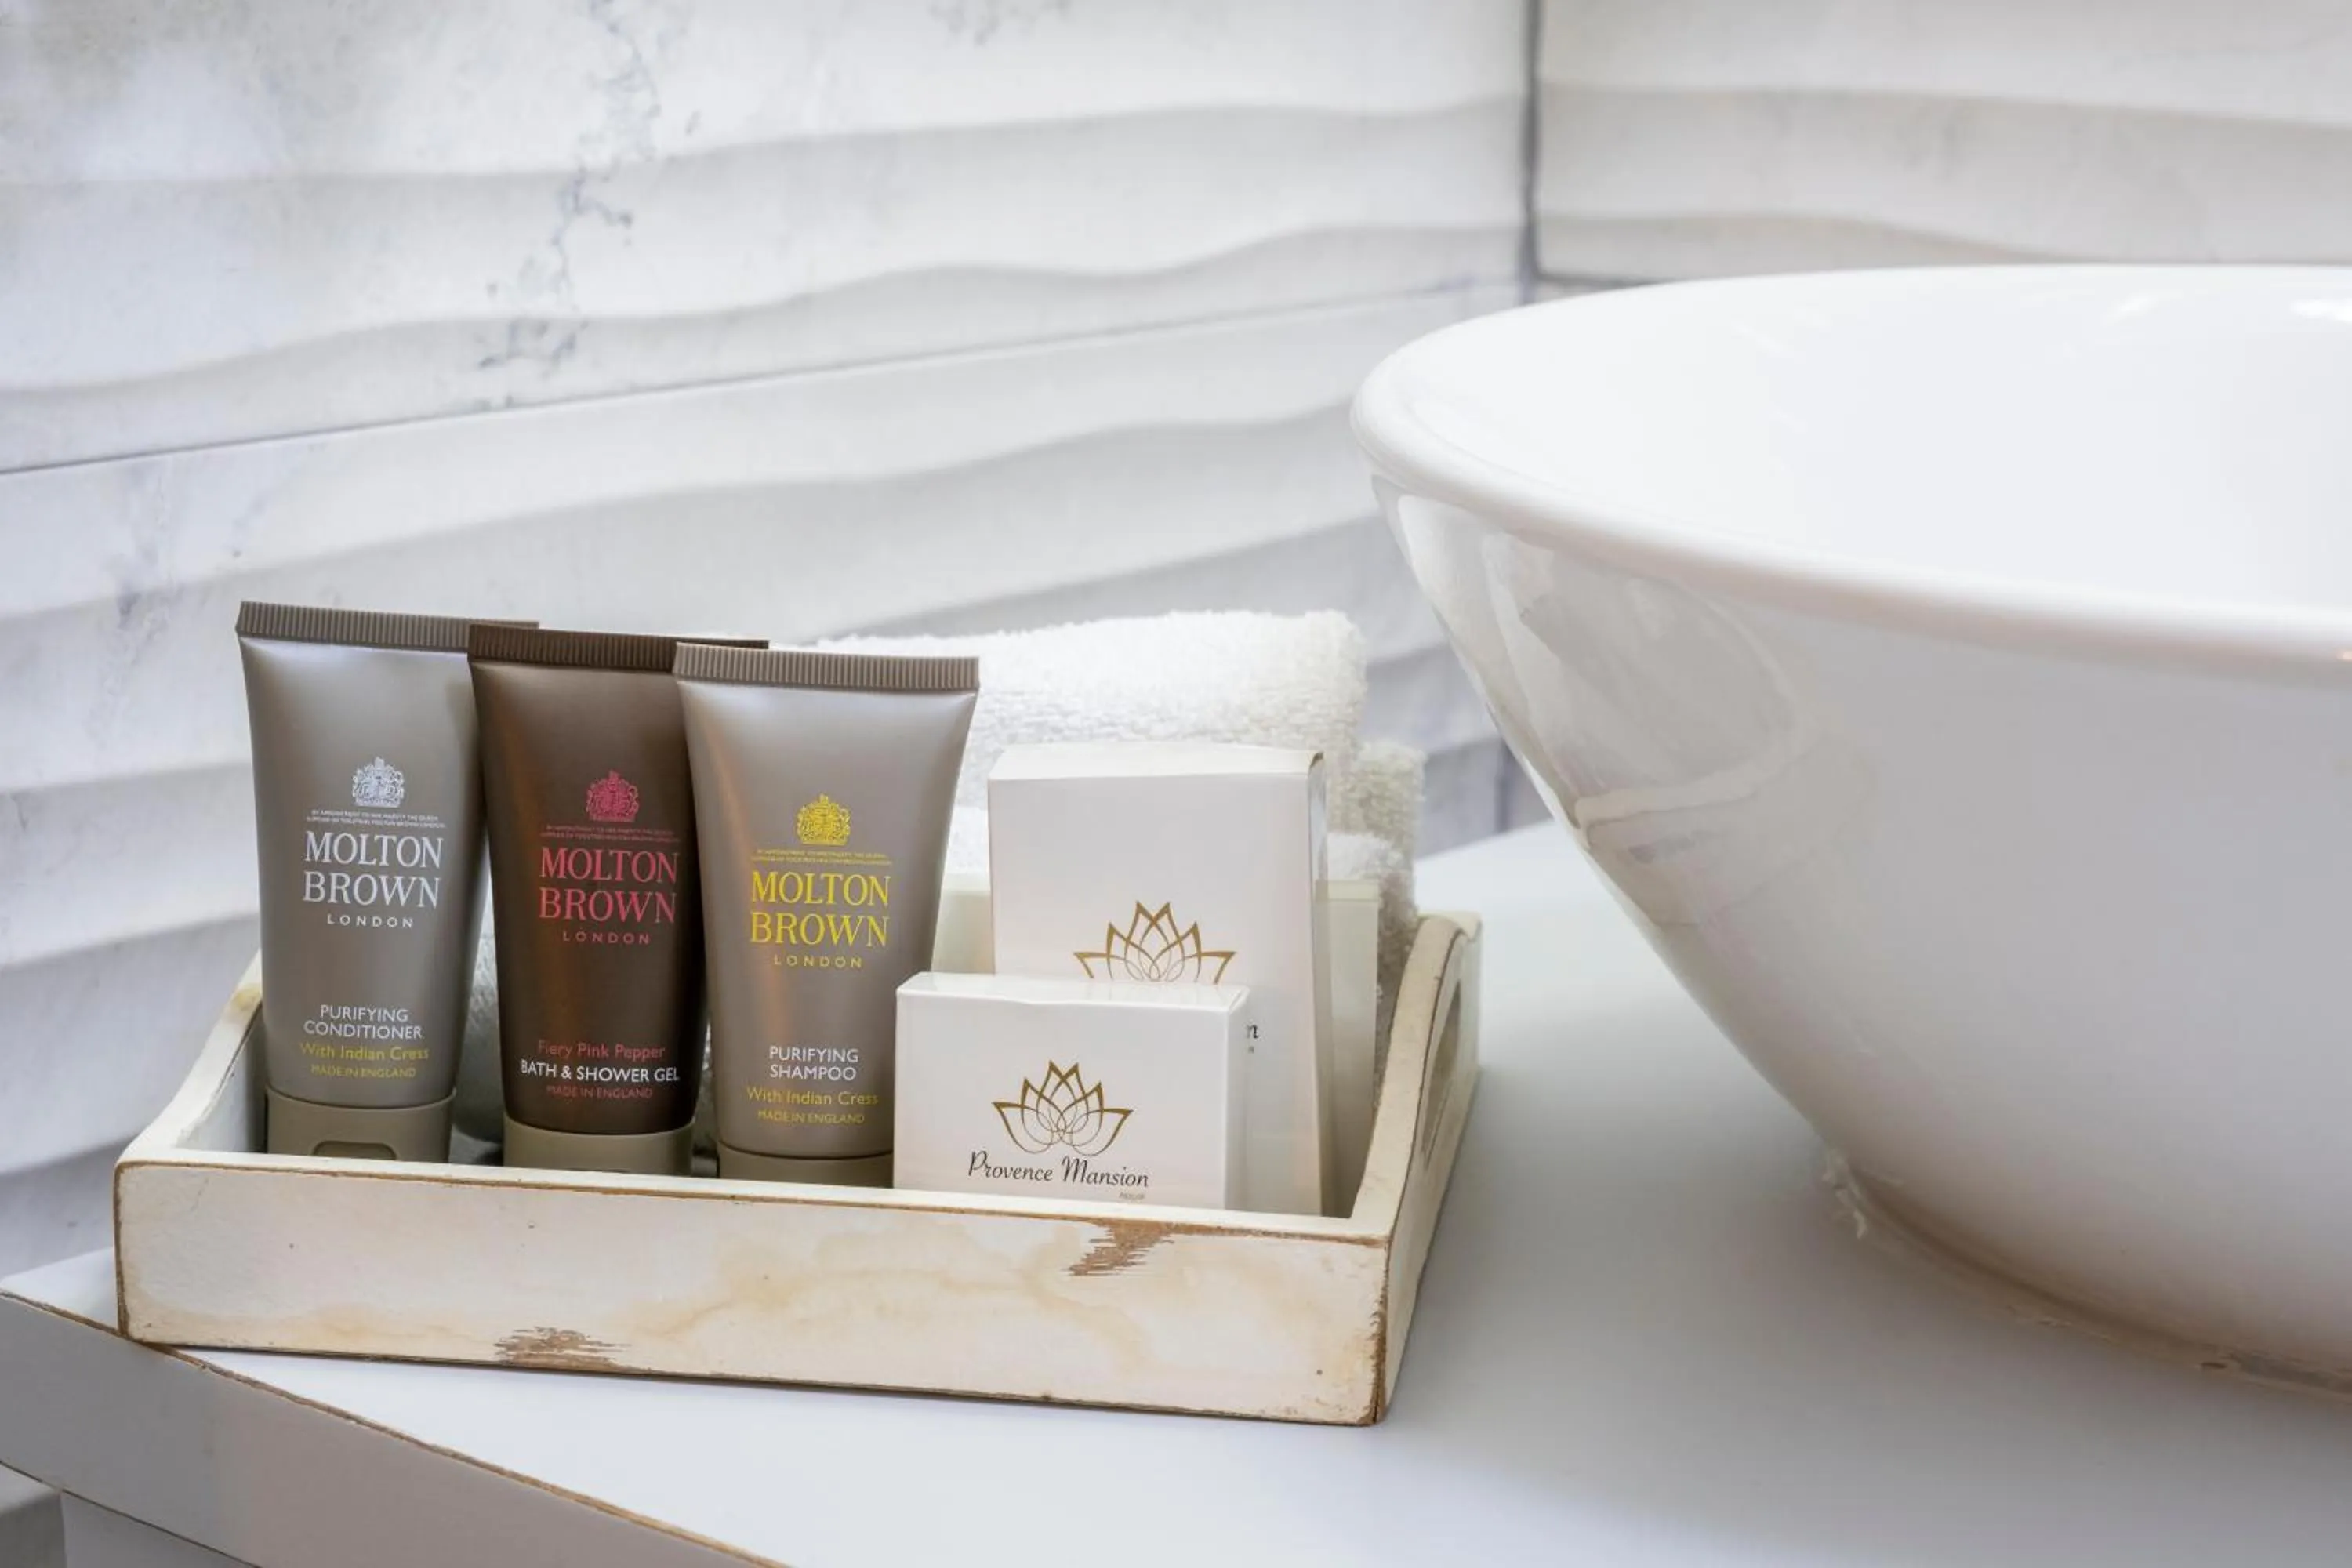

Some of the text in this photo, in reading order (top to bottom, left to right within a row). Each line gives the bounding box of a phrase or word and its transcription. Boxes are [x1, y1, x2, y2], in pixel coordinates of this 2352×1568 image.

[303, 830, 444, 869] MOLTON
[539, 846, 680, 884] MOLTON
[303, 870, 441, 909] BROWN
[752, 871, 891, 907] MOLTON
[539, 886, 677, 924] BROWN
[327, 913, 413, 928] LONDON
[750, 910, 890, 947] BROWN
[563, 931, 651, 945] LONDON
[774, 954, 862, 968] LONDON
[320, 1004, 409, 1023] PURIFYING
[303, 1020, 423, 1040] CONDITIONER
[299, 1042, 430, 1060] With Indian Cress
[538, 1040, 666, 1062] Fiery Pink Pepper
[769, 1045, 859, 1063] PURIFYING
[361, 1067, 416, 1078] ENGLAND
[520, 1059, 681, 1083] BATH & SHOWER GEL
[770, 1064, 857, 1081] SHAMPOO
[597, 1087, 653, 1099] ENGLAND
[746, 1086, 879, 1105] With Indian Cress
[968, 1150, 1149, 1187] Provence Mansion
